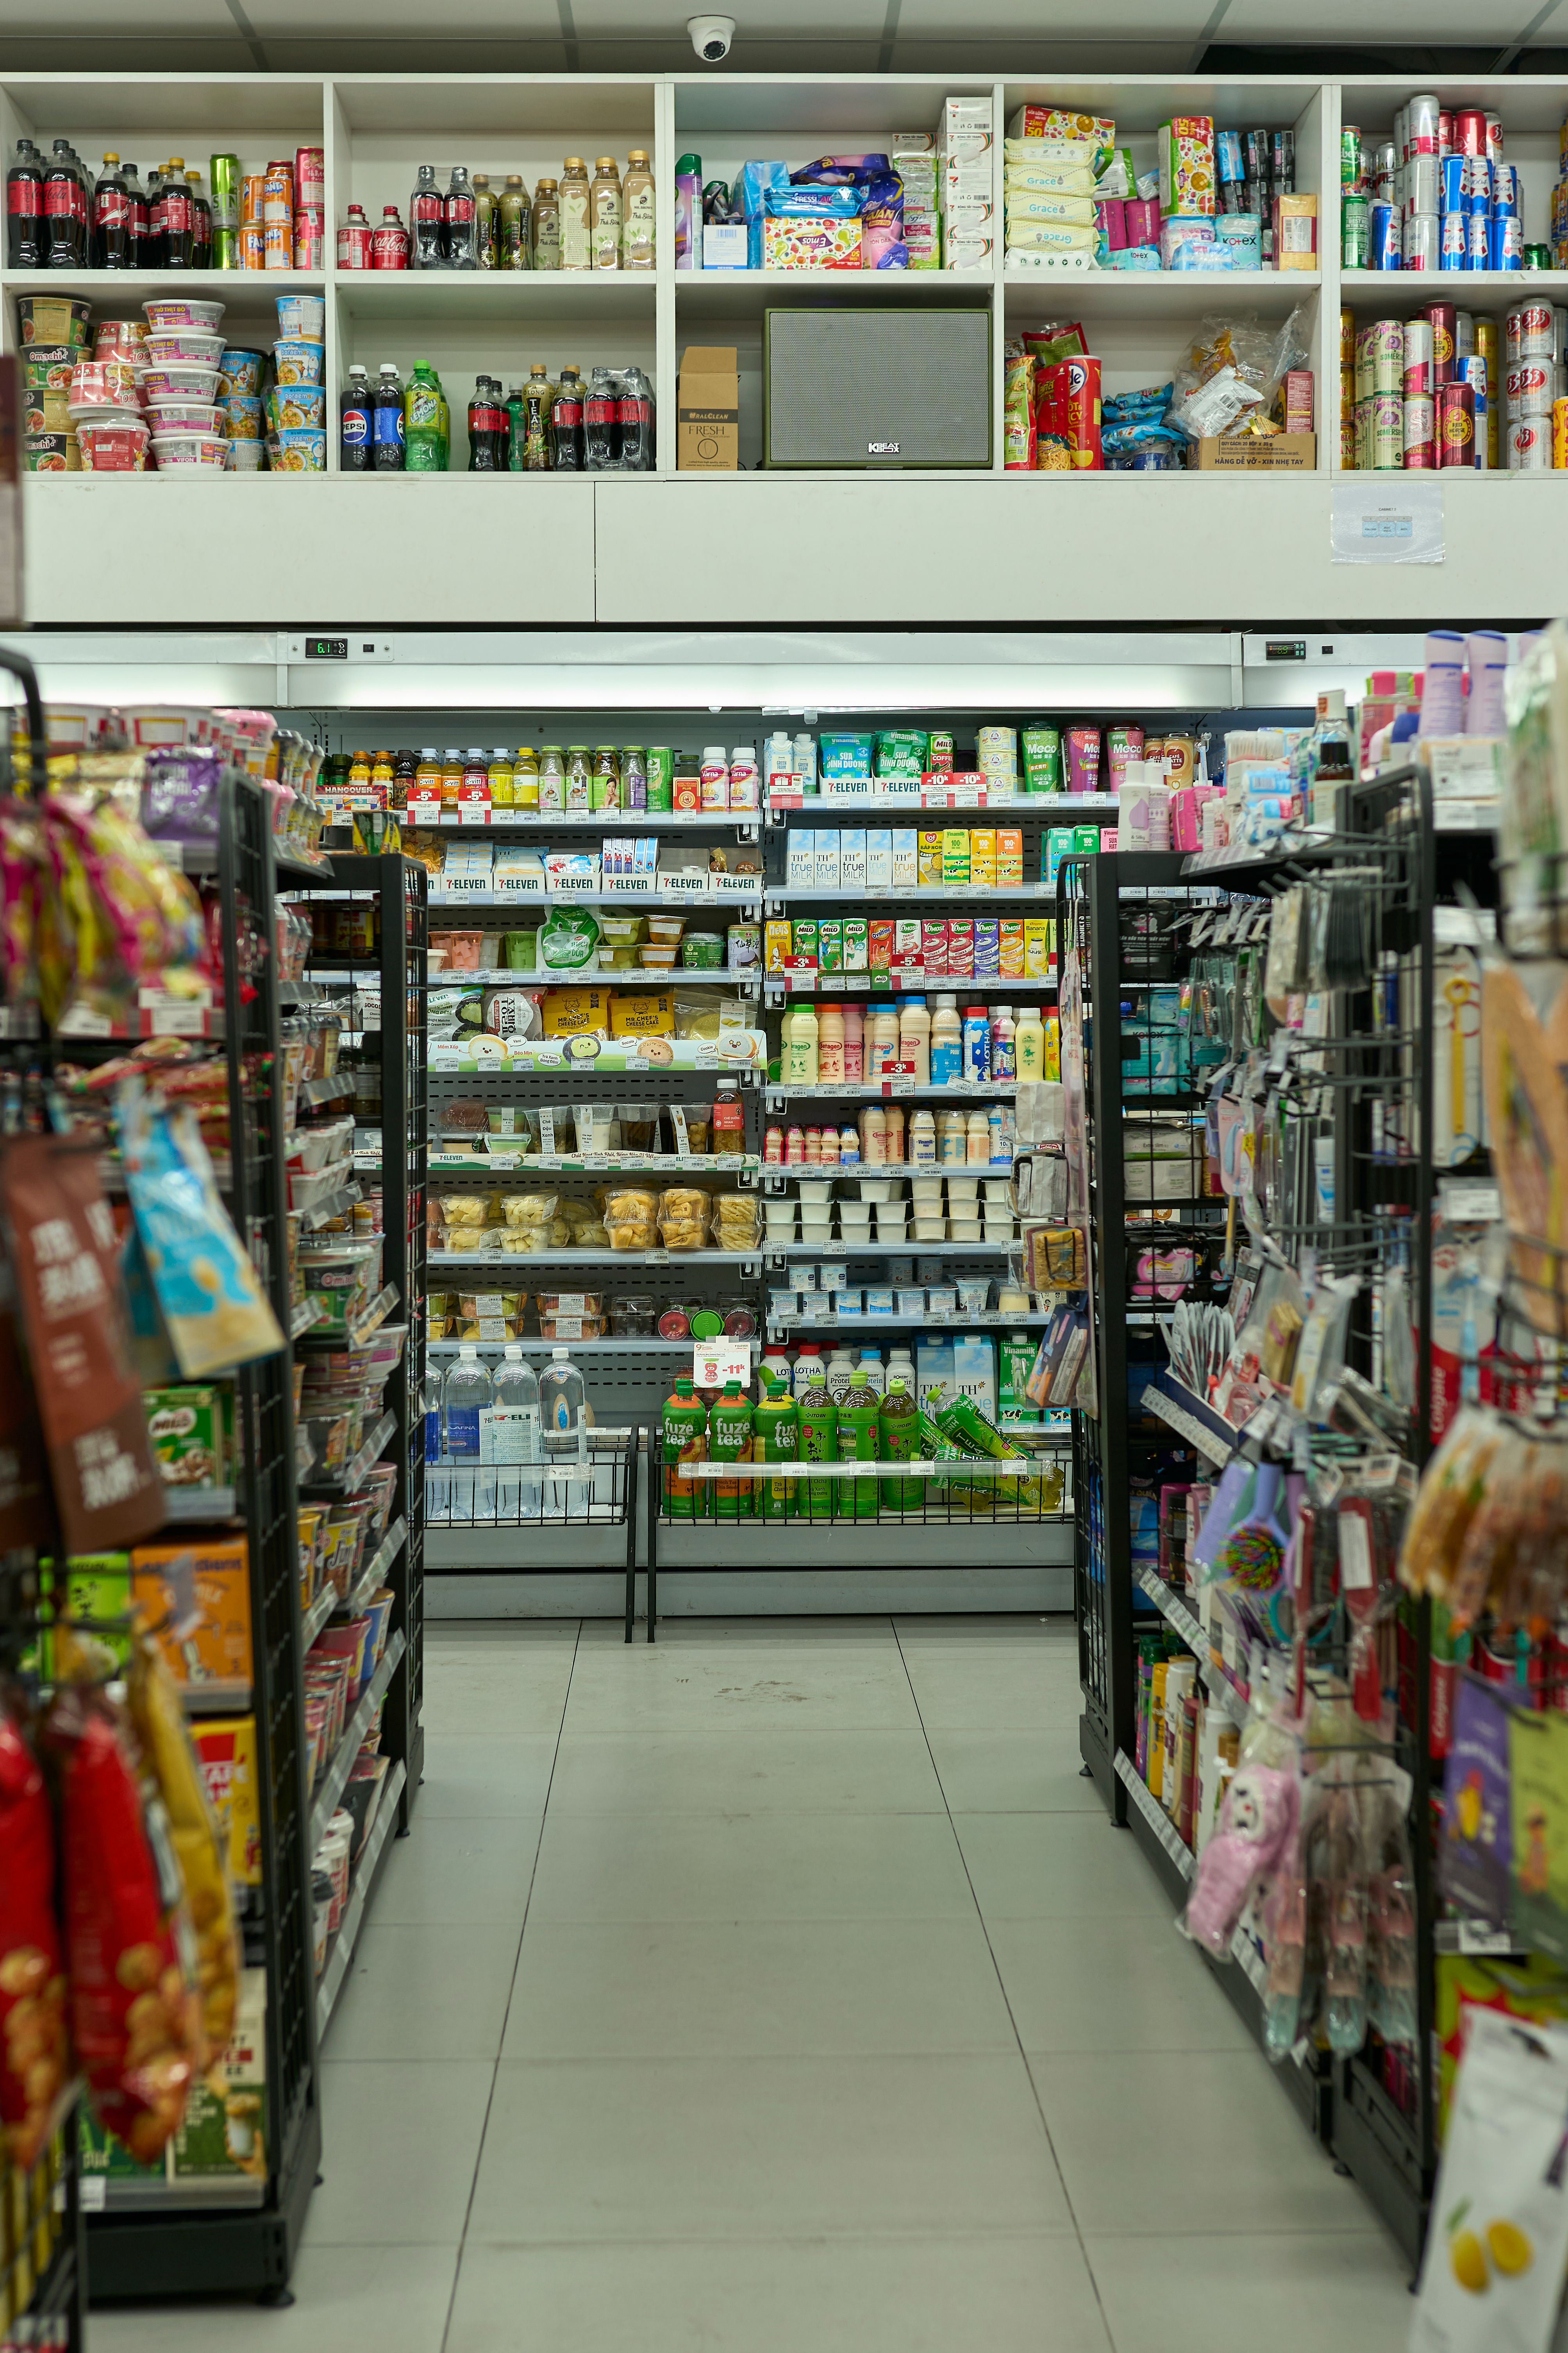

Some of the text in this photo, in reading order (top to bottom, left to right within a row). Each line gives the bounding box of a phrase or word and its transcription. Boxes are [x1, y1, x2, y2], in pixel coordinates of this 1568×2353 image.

[1027, 127, 1042, 136] 50
[1178, 118, 1189, 135] 50
[1029, 204, 1058, 213] Grace
[1043, 234, 1072, 244] Grace
[1223, 237, 1256, 245] kotex
[30, 351, 62, 360] Omachi
[688, 426, 725, 437] FRESH
[1236, 456, 1245, 465] DỄ
[317, 643, 330, 653] 6.1
[891, 732, 919, 741] Vinamilk
[1028, 744, 1057, 754] Meco
[1113, 744, 1142, 754] Meco
[827, 759, 867, 768] DINH DƯỠNG
[880, 759, 896, 767] DINH
[872, 928, 891, 939] Ovaltine
[959, 1384, 977, 1395] TH
[665, 1417, 693, 1435] fuze
[716, 1418, 750, 1435] fuze
[666, 1434, 685, 1445] tea
[718, 1433, 742, 1445] tea
[775, 1435, 795, 1447] tea
